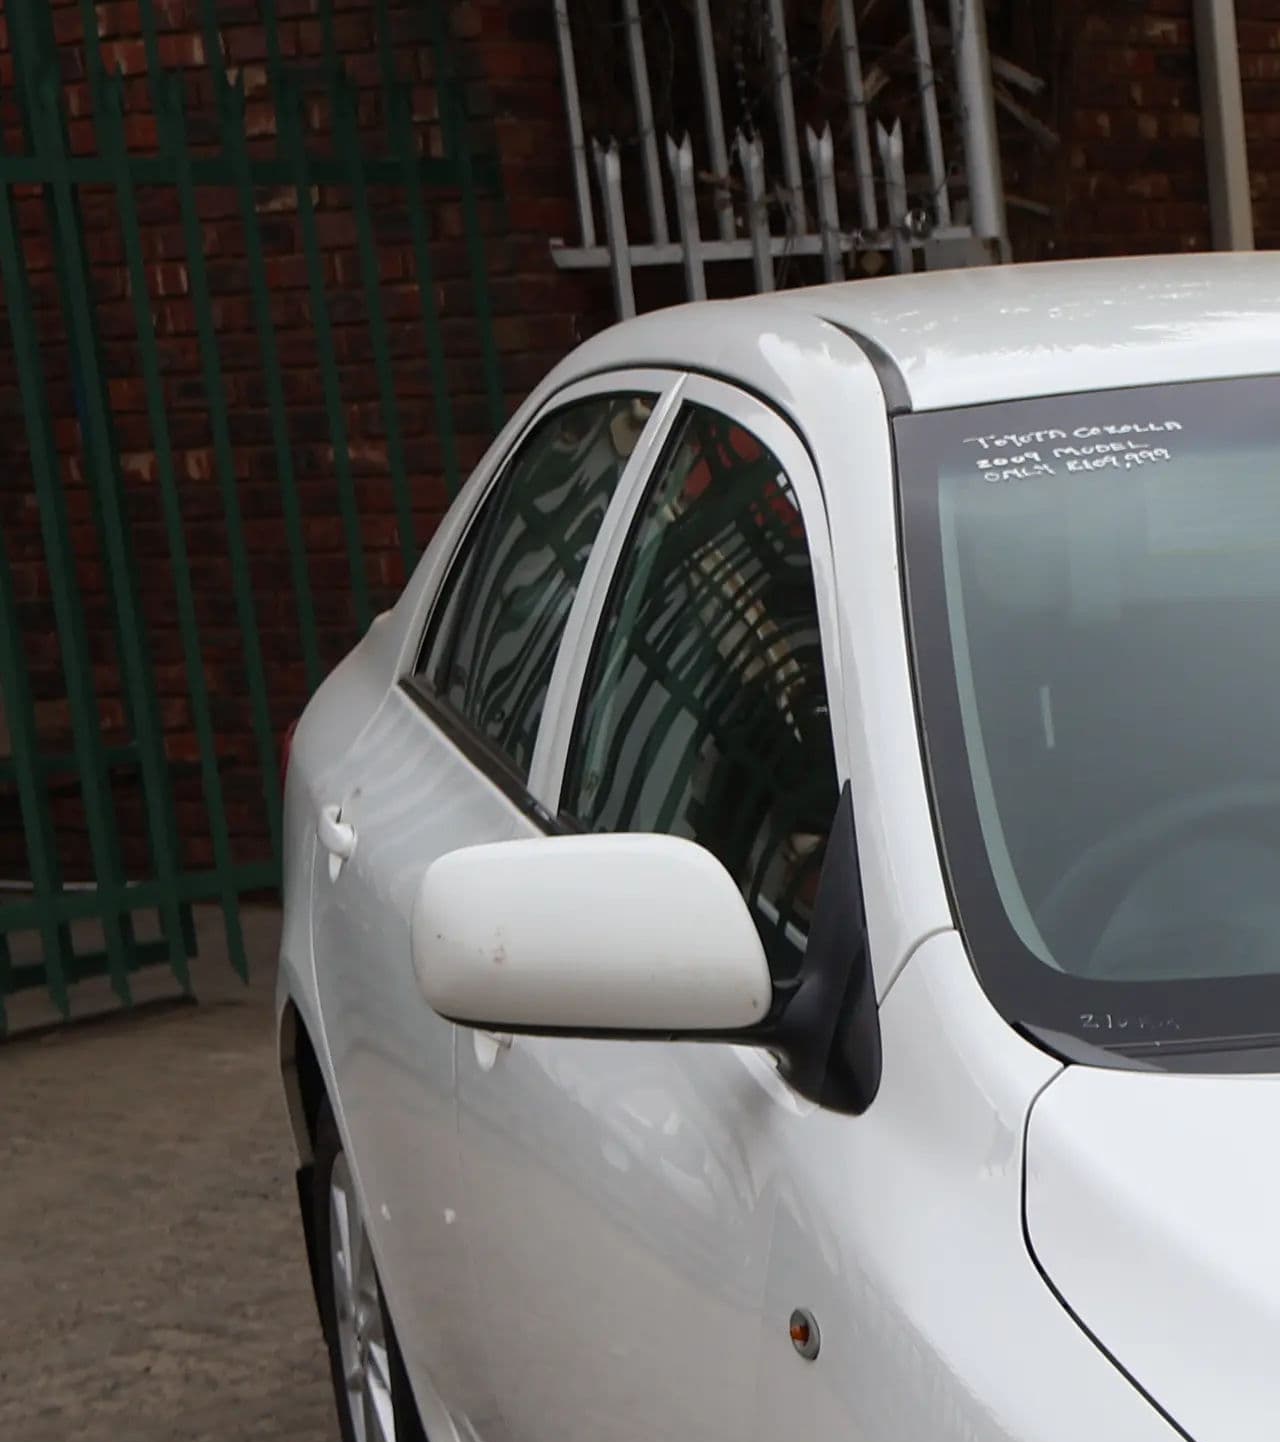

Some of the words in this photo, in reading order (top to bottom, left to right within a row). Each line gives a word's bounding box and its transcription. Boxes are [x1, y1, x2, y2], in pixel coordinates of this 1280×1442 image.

[962, 428, 1067, 449] TOYOTA
[1072, 420, 1183, 438] COROLLA
[976, 450, 1042, 469] 2009
[1052, 440, 1150, 458] MODEL
[984, 463, 1056, 482] ONLY
